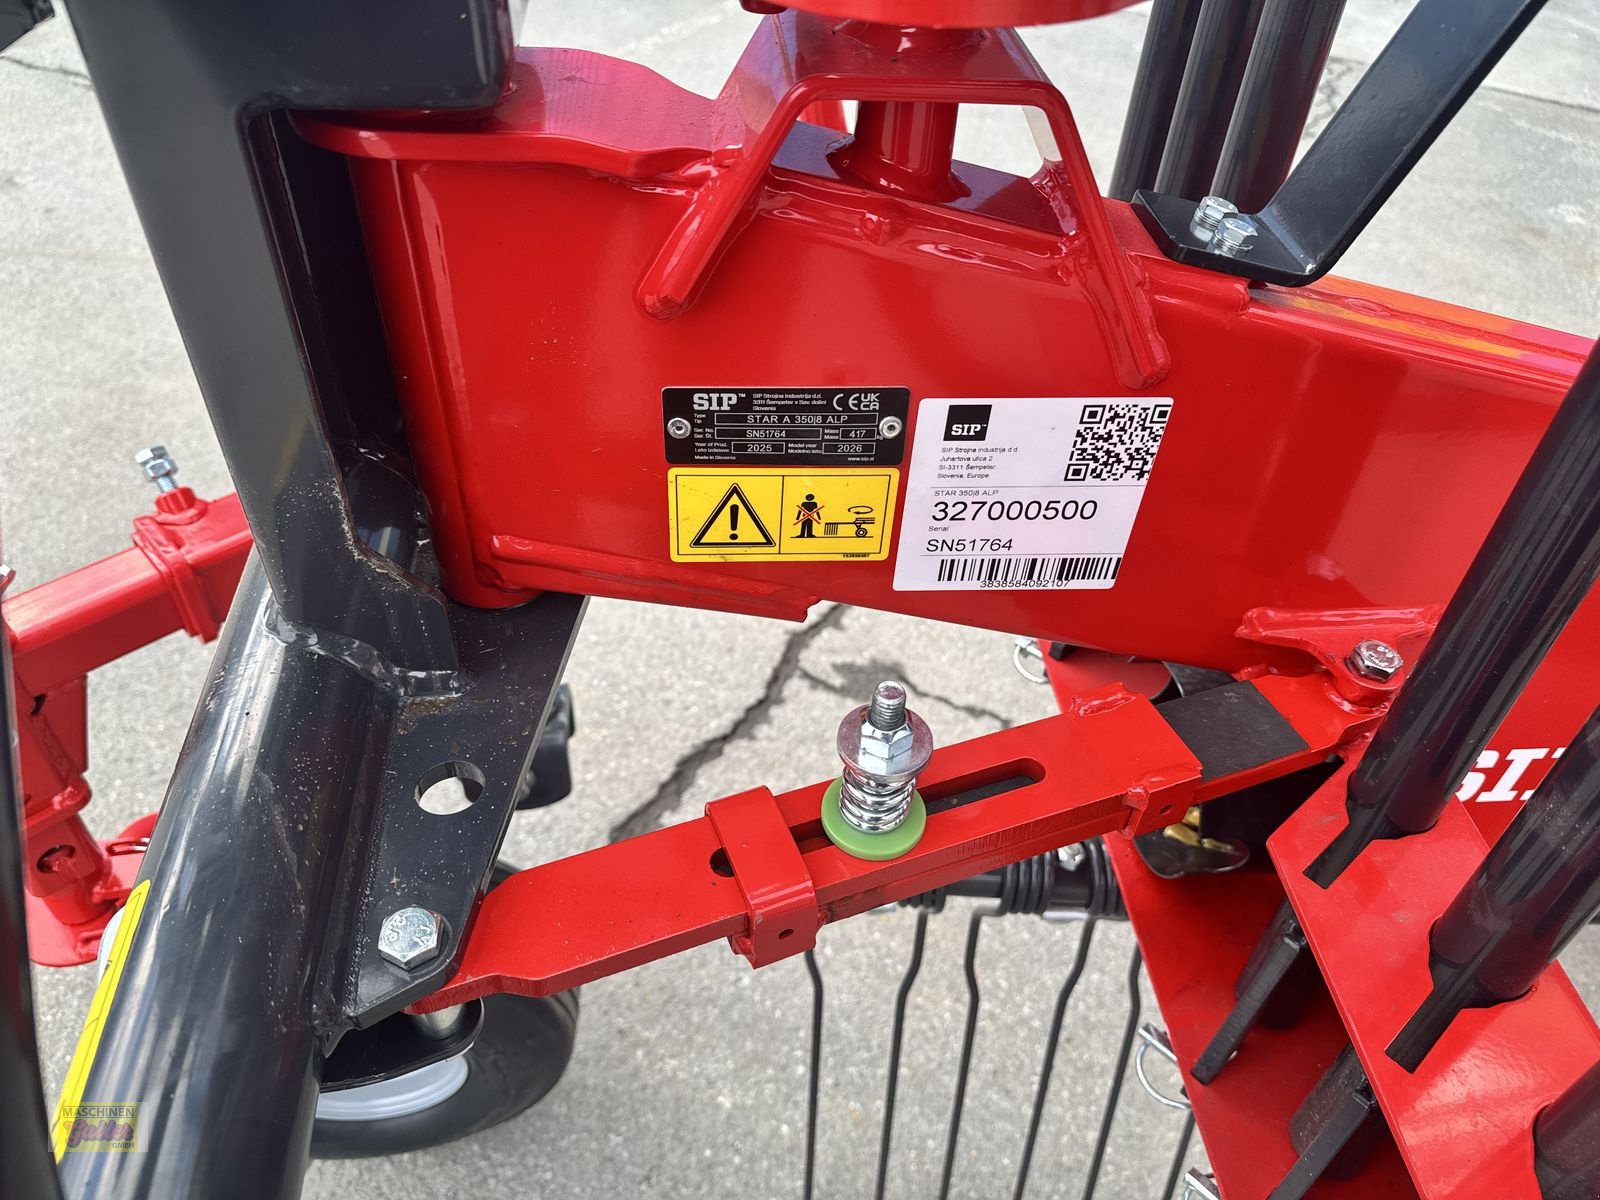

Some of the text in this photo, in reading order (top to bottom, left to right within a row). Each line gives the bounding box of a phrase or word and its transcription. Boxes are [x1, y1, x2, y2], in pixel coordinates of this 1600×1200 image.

[861, 393, 880, 401] UK
[860, 402, 880, 410] CA
[747, 415, 778, 423] STAR
[826, 415, 848, 423] ALP
[746, 430, 785, 438] SN51764
[849, 430, 866, 438] 417
[747, 444, 772, 452] 2025
[932, 500, 1098, 521] 327000500
[926, 538, 1013, 552] SN51764
[980, 579, 1071, 588] 3838584092107
[1455, 747, 1567, 803] SI
